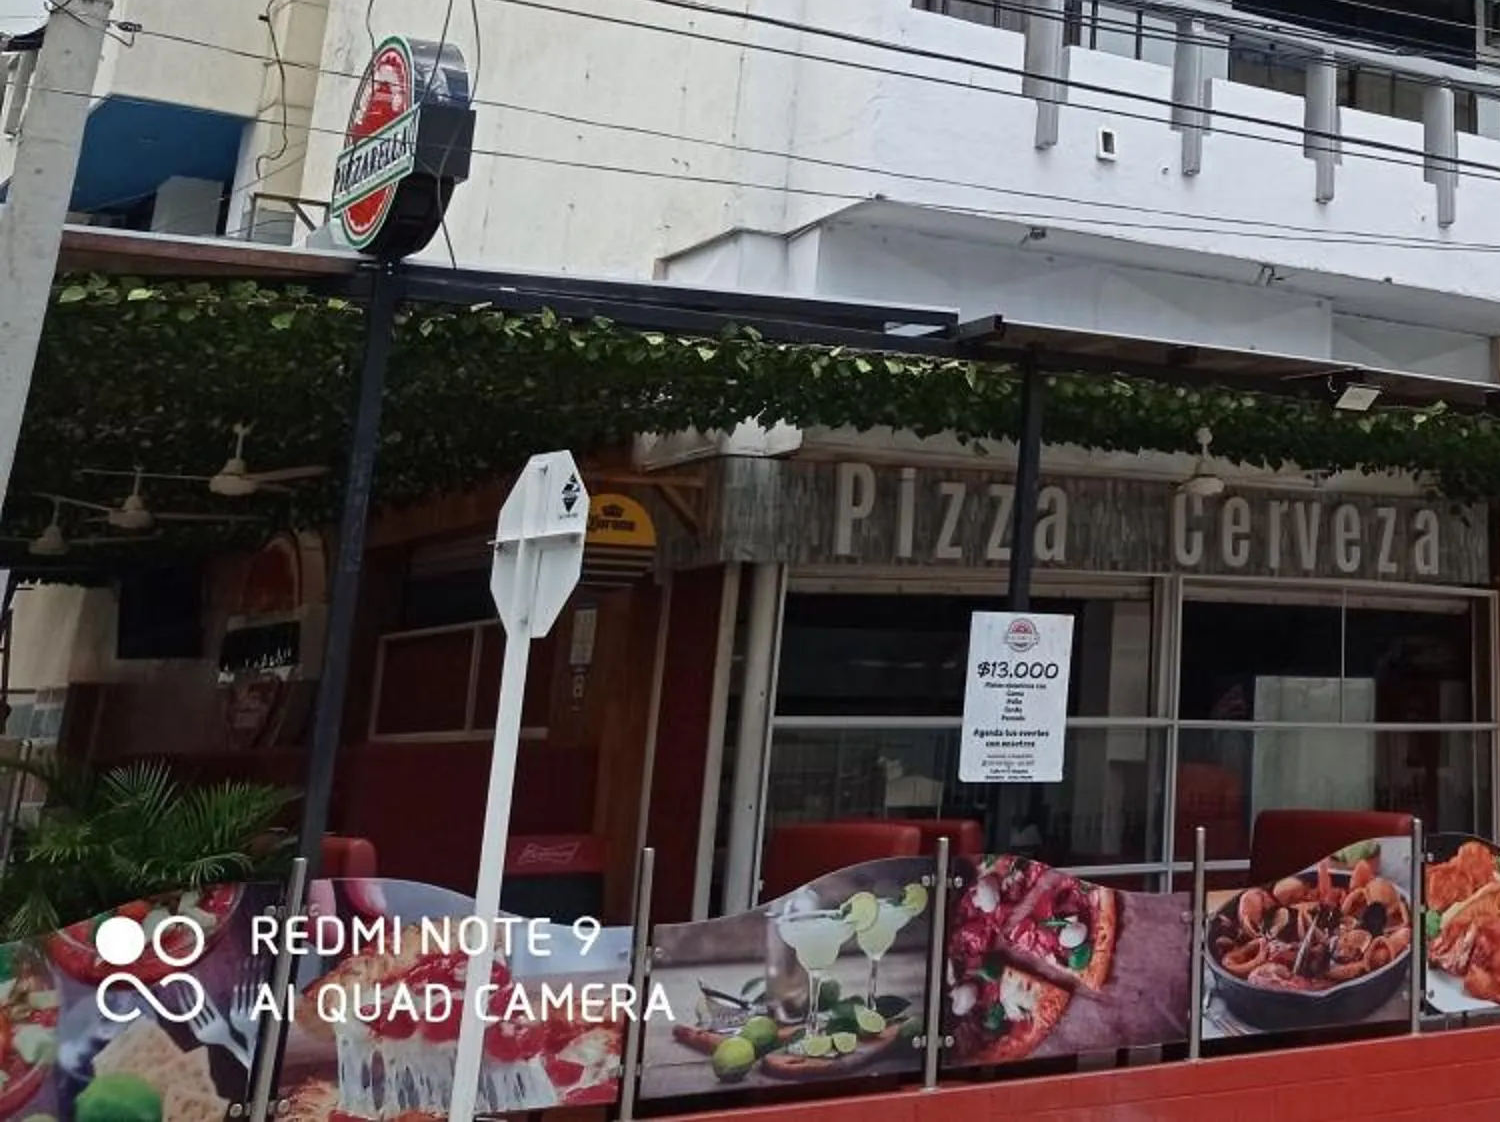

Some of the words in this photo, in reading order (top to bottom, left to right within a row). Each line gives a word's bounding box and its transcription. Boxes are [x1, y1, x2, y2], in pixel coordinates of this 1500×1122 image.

[835, 461, 1069, 561] Pizza
[1173, 490, 1440, 575] Cerveza
[976, 661, 1060, 679] $13.000
